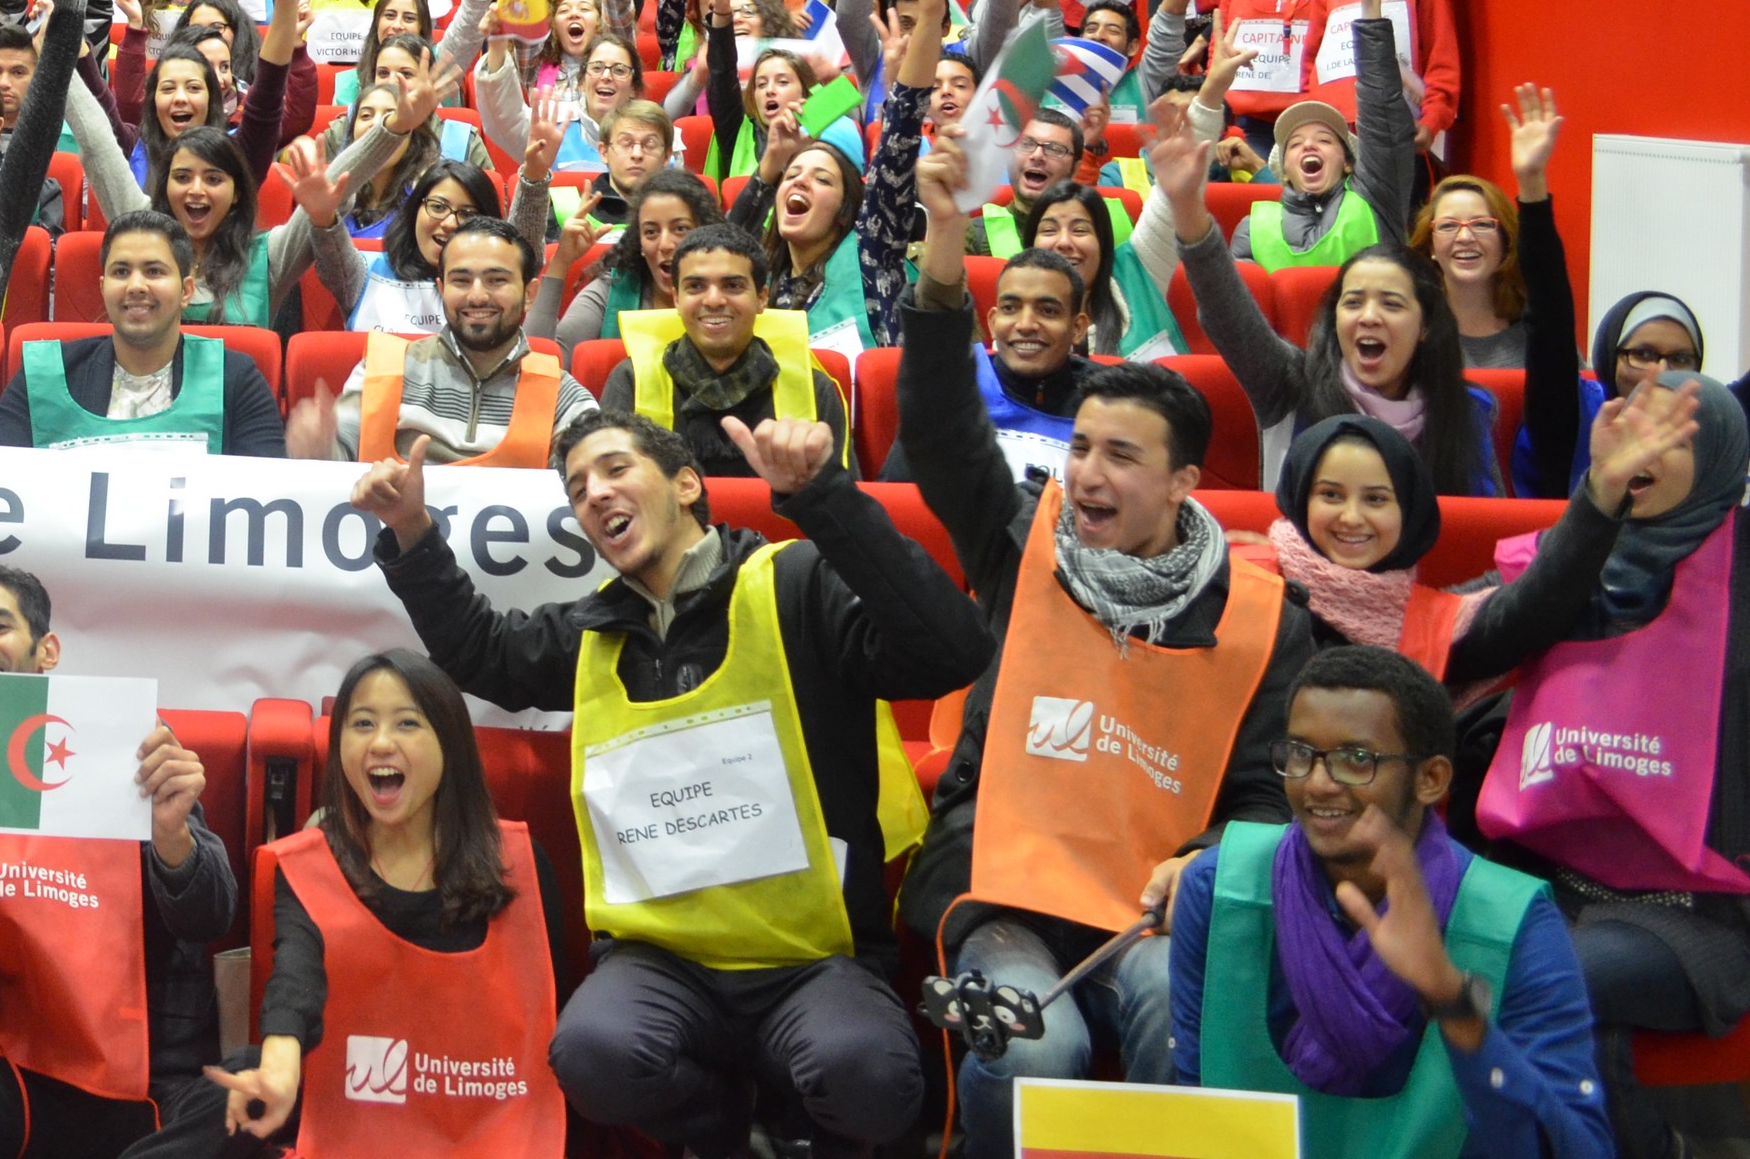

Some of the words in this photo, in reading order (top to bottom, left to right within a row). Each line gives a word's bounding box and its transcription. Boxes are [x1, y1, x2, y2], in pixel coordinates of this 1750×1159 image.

[331, 32, 362, 41] EQUIPE
[316, 48, 348, 56] VICTOR
[351, 48, 363, 56] HU
[85, 472, 597, 579] Limoes
[1099, 714, 1178, 771] Université
[1556, 725, 1661, 754] Université
[722, 755, 747, 765] Equipe
[1095, 735, 1121, 754] de
[1127, 743, 1182, 794] Limoges
[1554, 747, 1576, 765] de
[1582, 745, 1671, 777] Limoges
[650, 781, 713, 808] EQUIPE
[616, 824, 658, 845] RENE
[665, 803, 763, 836] DESCARTES
[24, 879, 99, 908] Limoges
[415, 1052, 515, 1077] Université
[413, 1074, 437, 1094] de
[445, 1075, 528, 1100] Limoges
